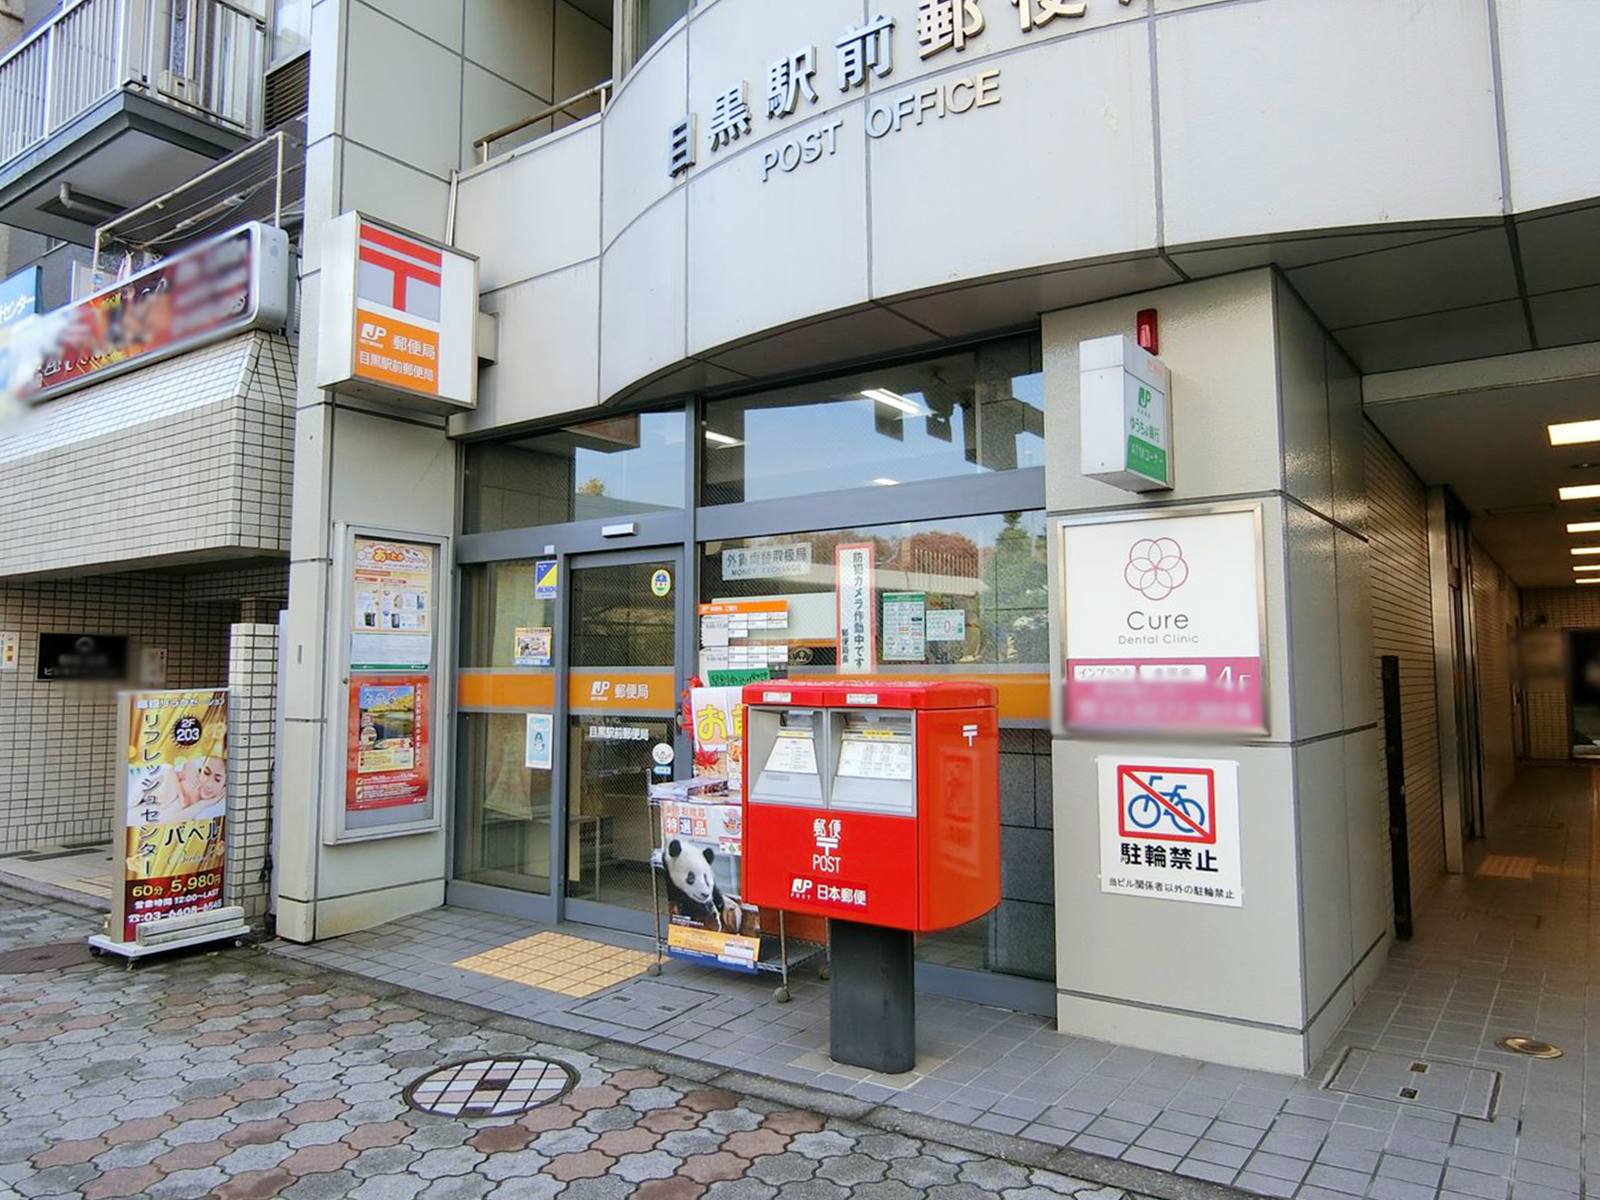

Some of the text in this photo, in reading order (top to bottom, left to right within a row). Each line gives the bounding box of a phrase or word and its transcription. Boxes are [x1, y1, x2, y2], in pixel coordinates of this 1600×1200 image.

[762, 69, 1002, 182] POST OFFICE
[392, 334, 435, 361] 郵便局
[360, 350, 434, 383] 目黒駅前郵便局
[727, 547, 806, 568] 外貨両替取扱局
[731, 566, 756, 576] MONEY
[853, 552, 865, 668] 防犯カメラ作動中です
[1126, 611, 1189, 631] Cure
[1118, 634, 1199, 645] Dental Clinic
[614, 683, 649, 700] 郵便局
[181, 719, 195, 728] 2F
[589, 726, 649, 741] 目黒駅前郵便局
[176, 729, 200, 742] 203
[138, 713, 160, 876] リフレッシュセンター
[165, 821, 220, 846] バベル
[666, 816, 707, 837] 特選品
[813, 818, 842, 839] 郵便
[812, 854, 841, 873] POST
[1120, 842, 1218, 873] 駐輪禁止
[132, 885, 163, 897] 60分
[817, 884, 867, 906] 日本郵便
[1109, 877, 1235, 900] 当ビル関係者以外の駐輪禁止
[134, 897, 172, 910] 営業時間
